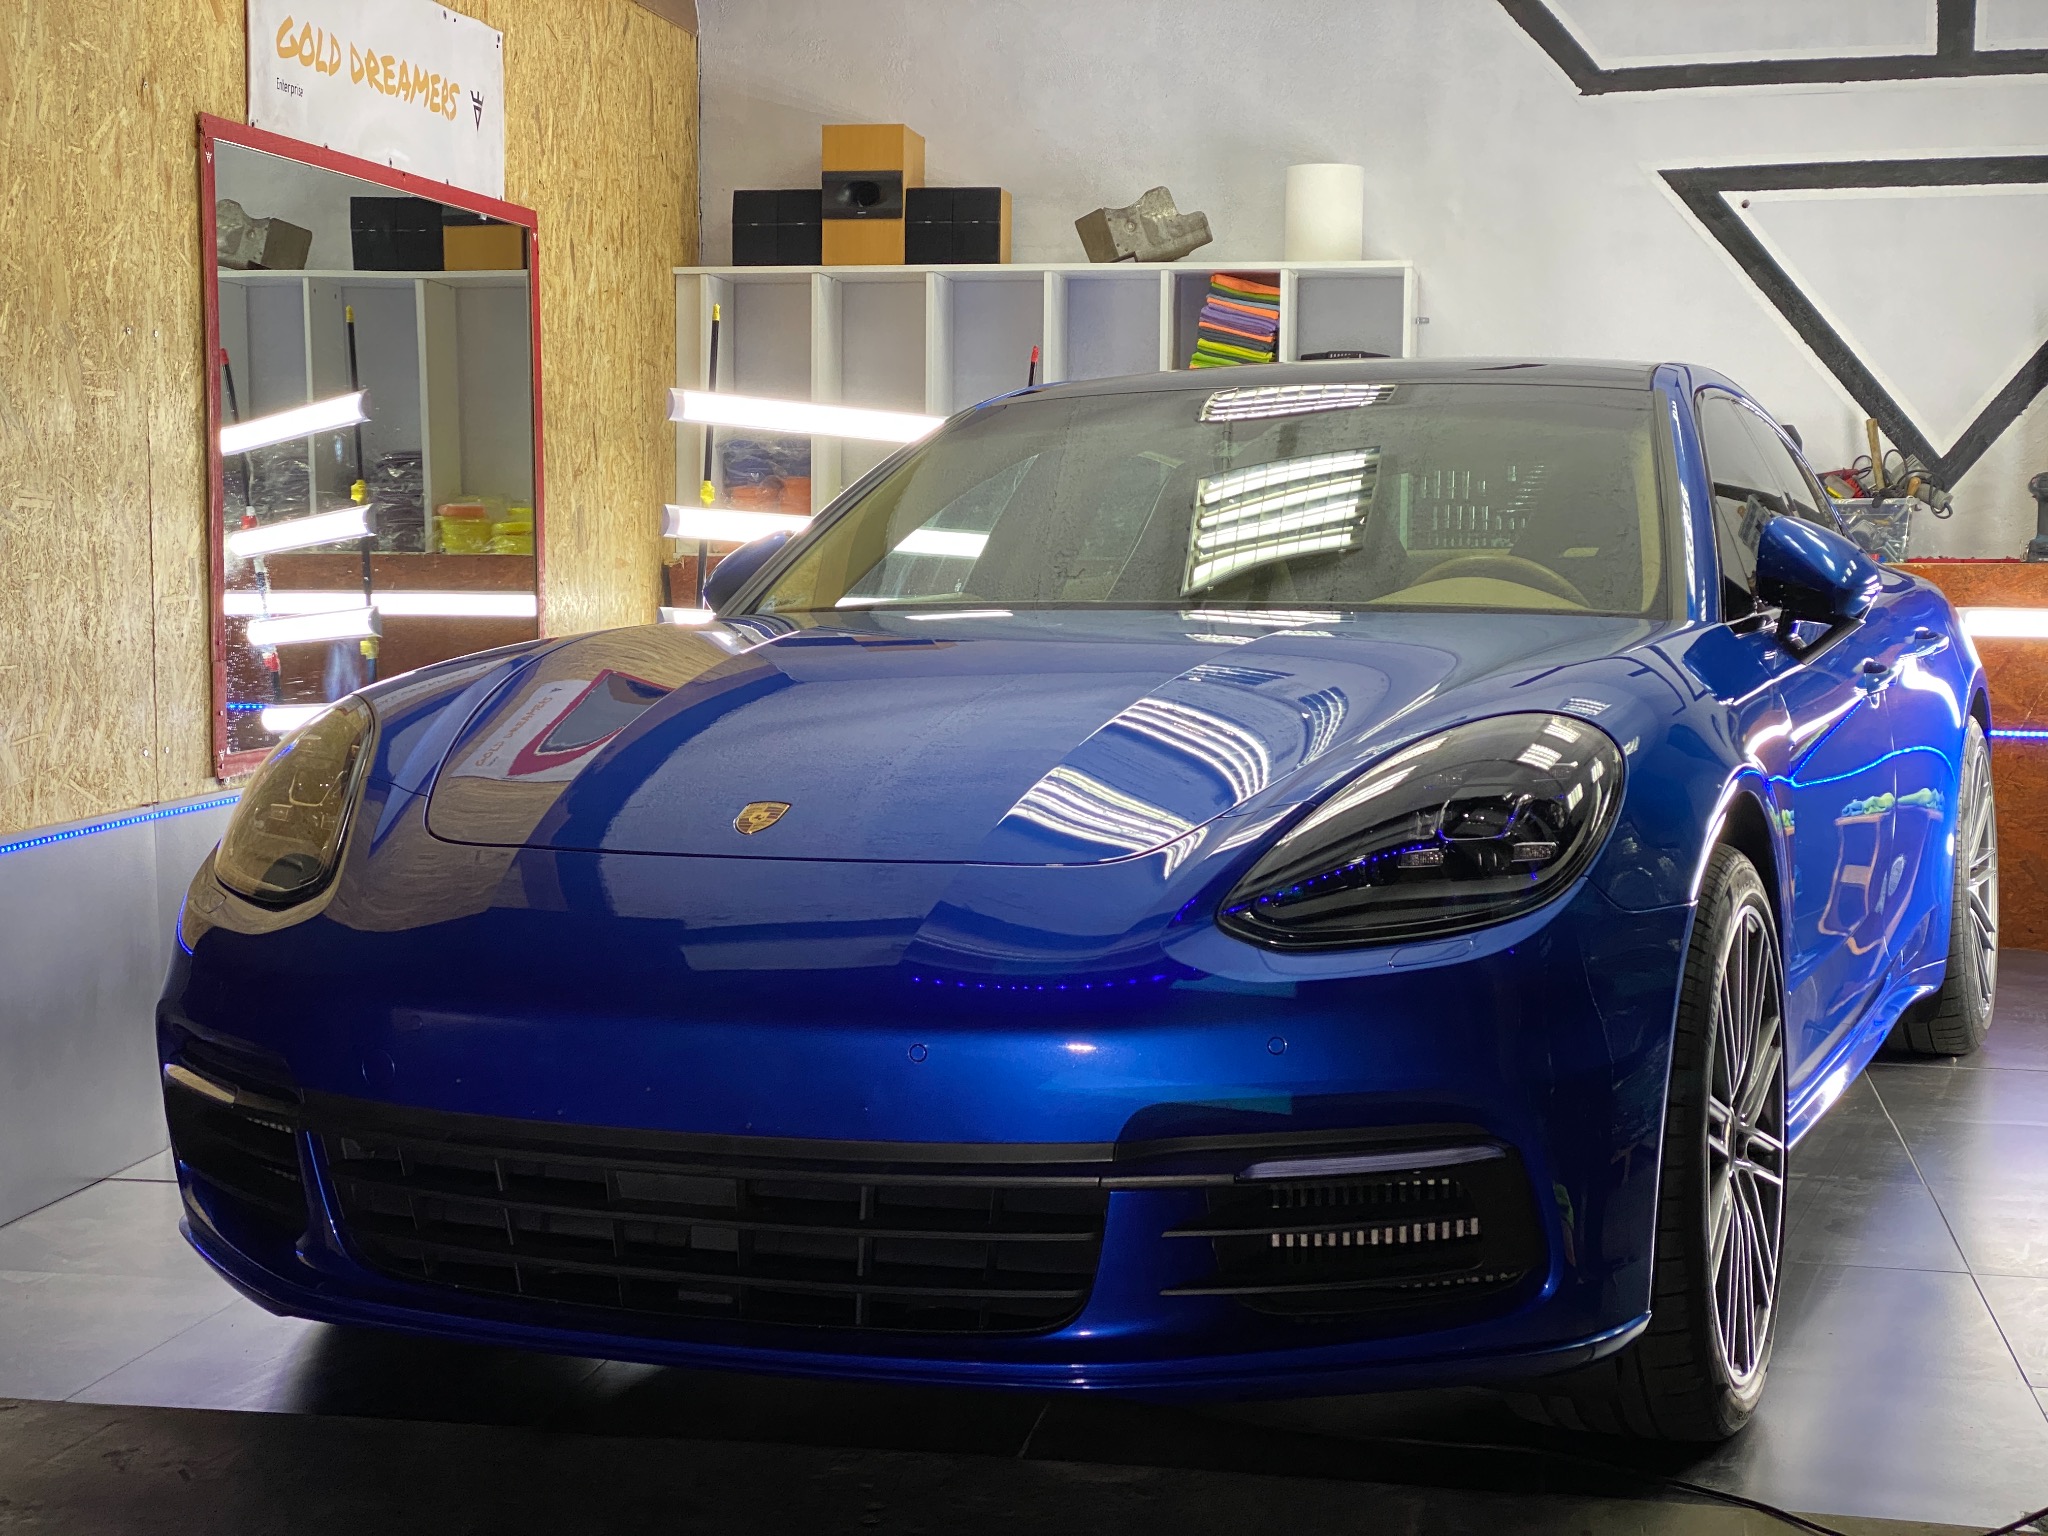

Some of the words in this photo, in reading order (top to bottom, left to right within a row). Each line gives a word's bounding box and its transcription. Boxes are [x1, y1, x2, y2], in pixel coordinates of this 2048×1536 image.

[276, 15, 341, 76] GOLD
[350, 42, 460, 121] DREAMERS
[276, 77, 303, 98] Enterprise
